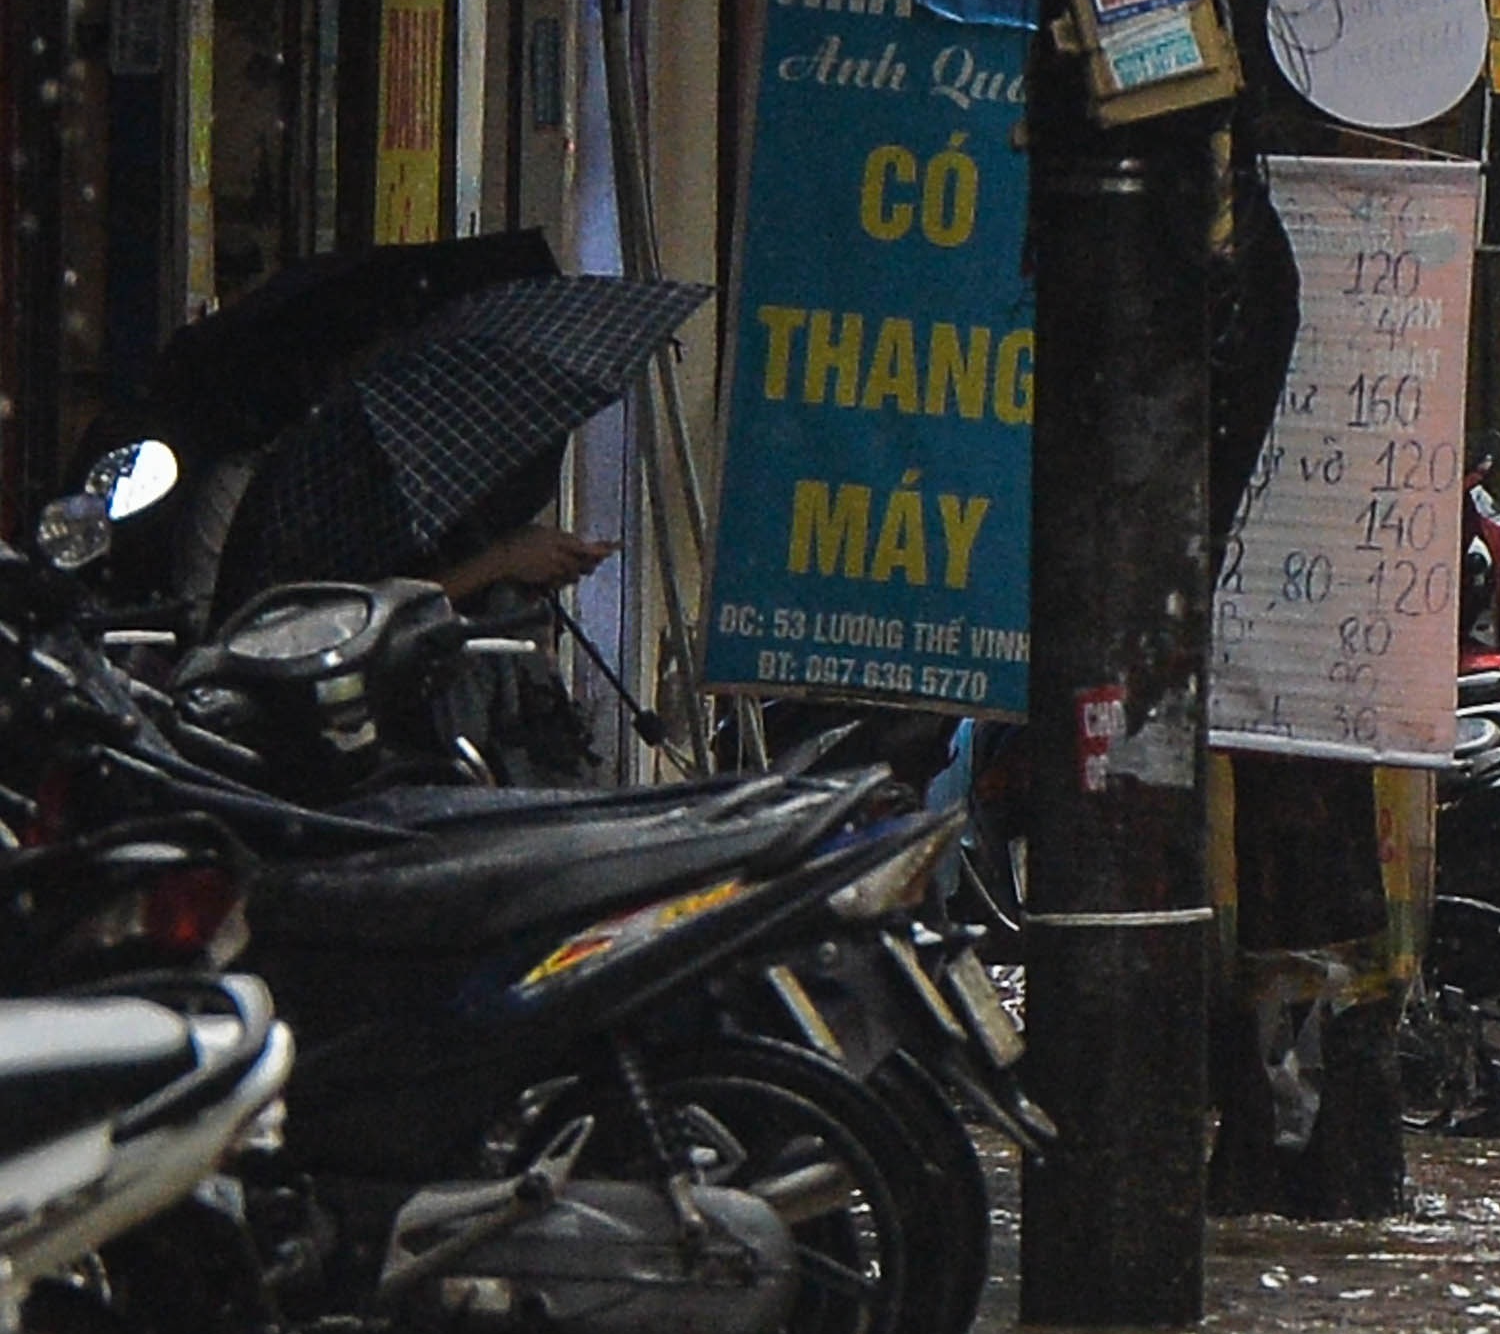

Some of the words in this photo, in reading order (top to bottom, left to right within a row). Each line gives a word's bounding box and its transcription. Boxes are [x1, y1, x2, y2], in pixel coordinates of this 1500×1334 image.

[778, 34, 908, 91] Anh
[861, 132, 979, 248] CÓ
[1343, 250, 1420, 298] 120
[757, 304, 1036, 426] THANG
[1347, 372, 1422, 428] 160
[1370, 440, 1458, 493] 120
[787, 468, 991, 589] MÁY
[1354, 499, 1436, 551] 140
[772, 607, 806, 641] 53
[912, 616, 963, 656] THẾ
